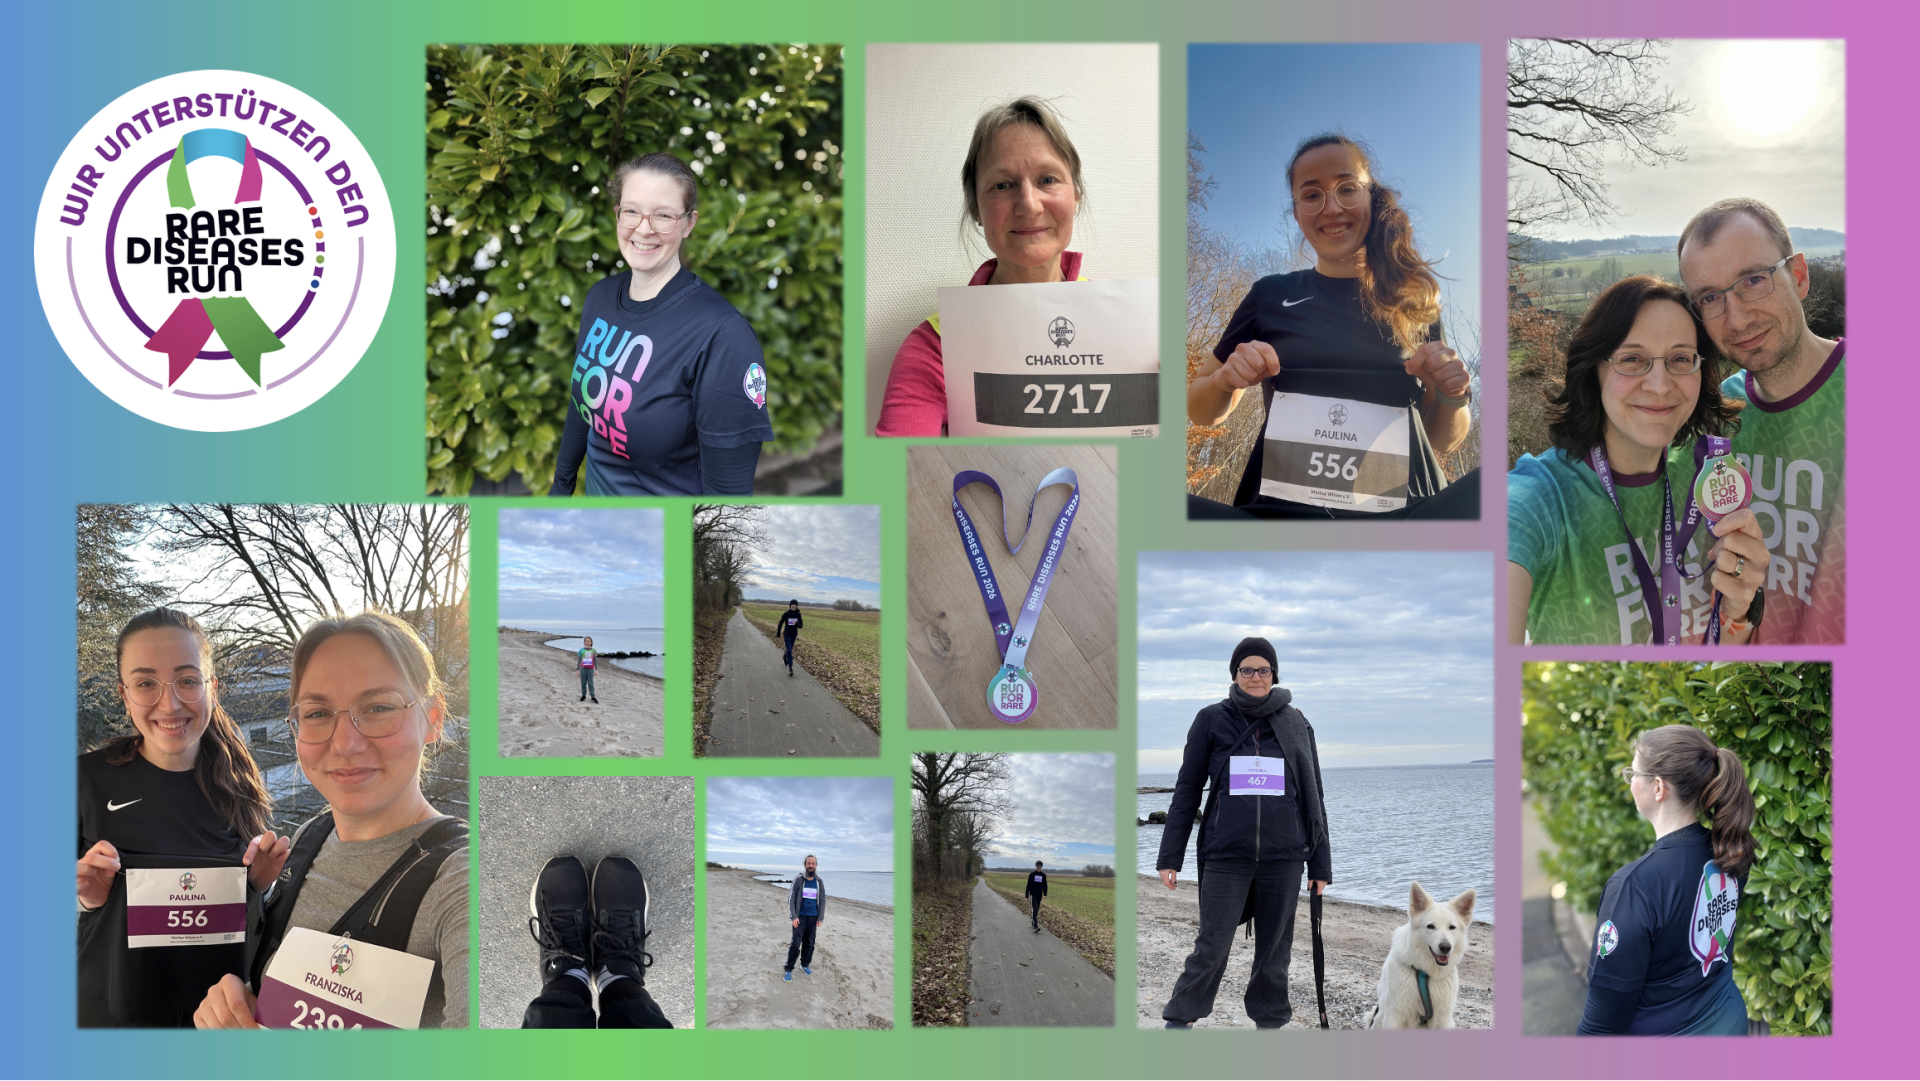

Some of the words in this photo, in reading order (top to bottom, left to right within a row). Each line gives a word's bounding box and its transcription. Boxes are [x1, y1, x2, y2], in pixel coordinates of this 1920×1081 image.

[581, 317, 653, 383] RUN
[1025, 354, 1104, 366] CHARLOTTE
[570, 353, 633, 433] FOR
[1023, 383, 1112, 414] 2717
[1314, 428, 1358, 442] PAULINA
[1308, 452, 1358, 481] 556
[1709, 474, 1736, 490] RUN
[1711, 484, 1737, 501] FOR
[1713, 494, 1739, 509] RARE
[1748, 500, 1820, 564] OR
[956, 510, 980, 556] DISEASES
[975, 556, 988, 577] RUN
[983, 578, 997, 600] 2026
[1027, 585, 1042, 611] RARE
[1037, 538, 1061, 584] DISEASES
[1055, 517, 1068, 538] RUN
[1065, 494, 1079, 517] 2026
[1665, 534, 1673, 564] RARE
[1001, 683, 1024, 693] RUN
[1001, 693, 1024, 702] FOR
[1001, 702, 1024, 710] RARE
[1247, 776, 1268, 786] 467
[1697, 899, 1736, 932] DISEASES
[1707, 890, 1728, 916] RARE
[167, 909, 208, 928] 556
[305, 972, 363, 1004] FRANZISKA
